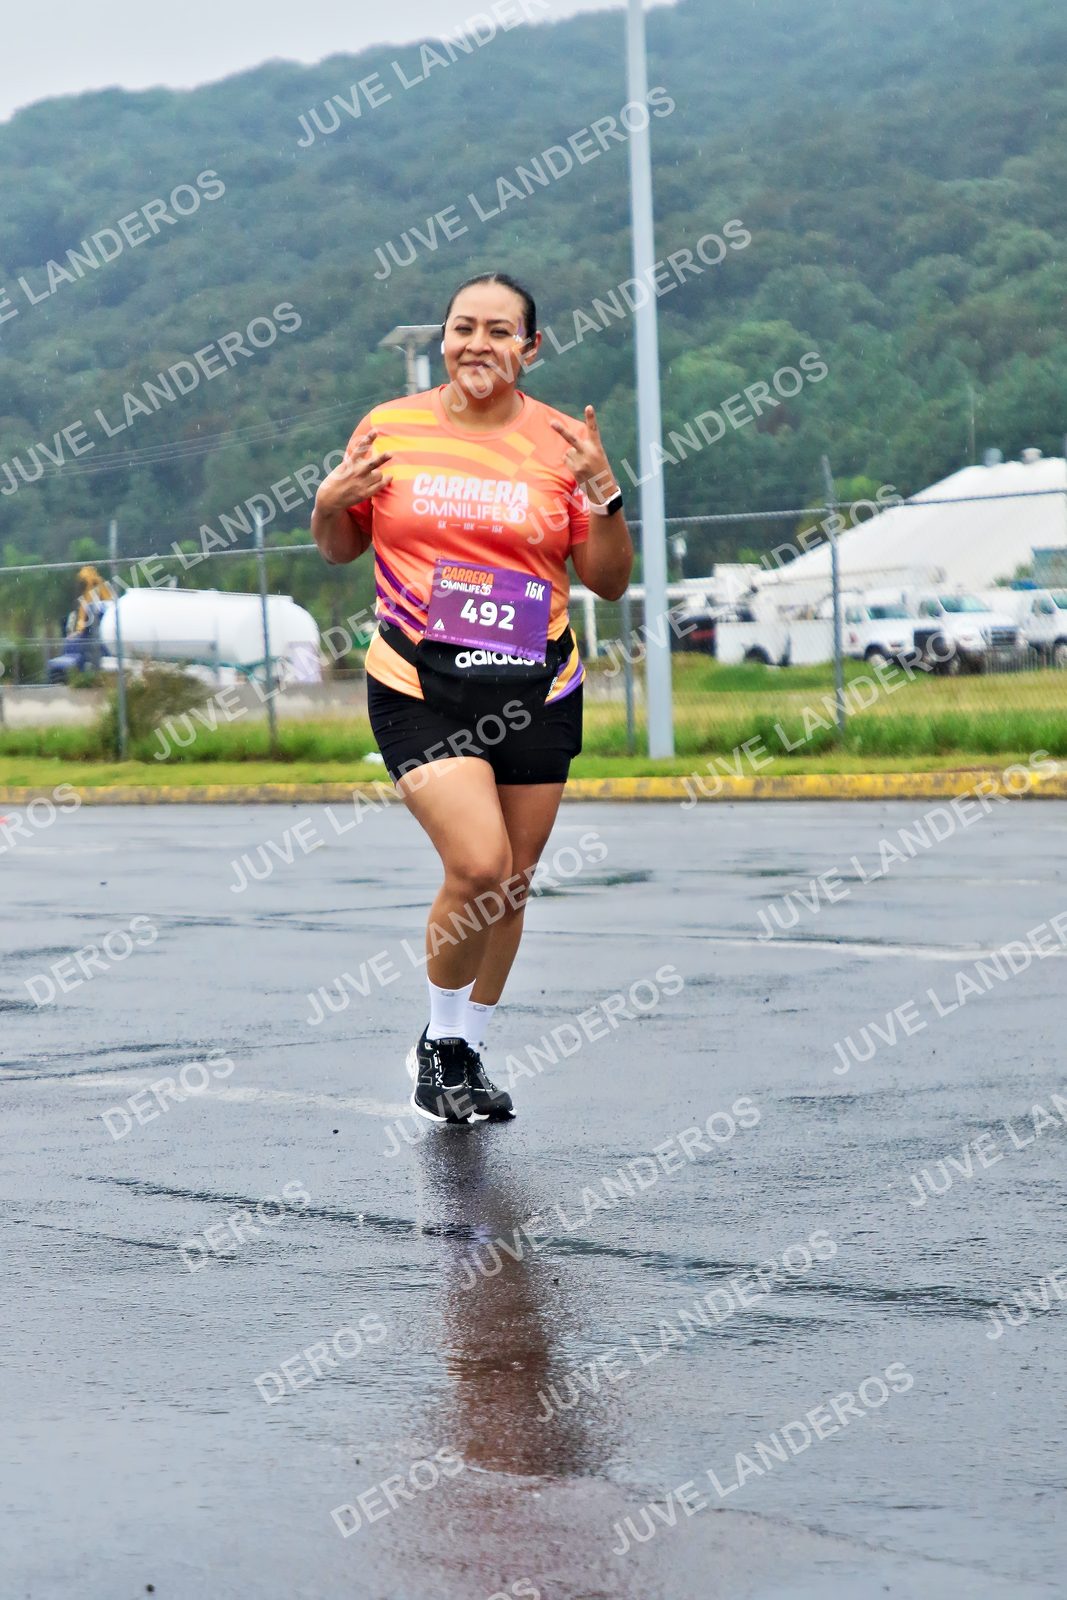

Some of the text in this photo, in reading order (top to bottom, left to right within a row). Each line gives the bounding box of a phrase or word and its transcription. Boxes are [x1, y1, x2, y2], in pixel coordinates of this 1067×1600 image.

[412, 473, 528, 509] CARRERA
[441, 566, 494, 585] CARRERA
[460, 598, 516, 630] 492
